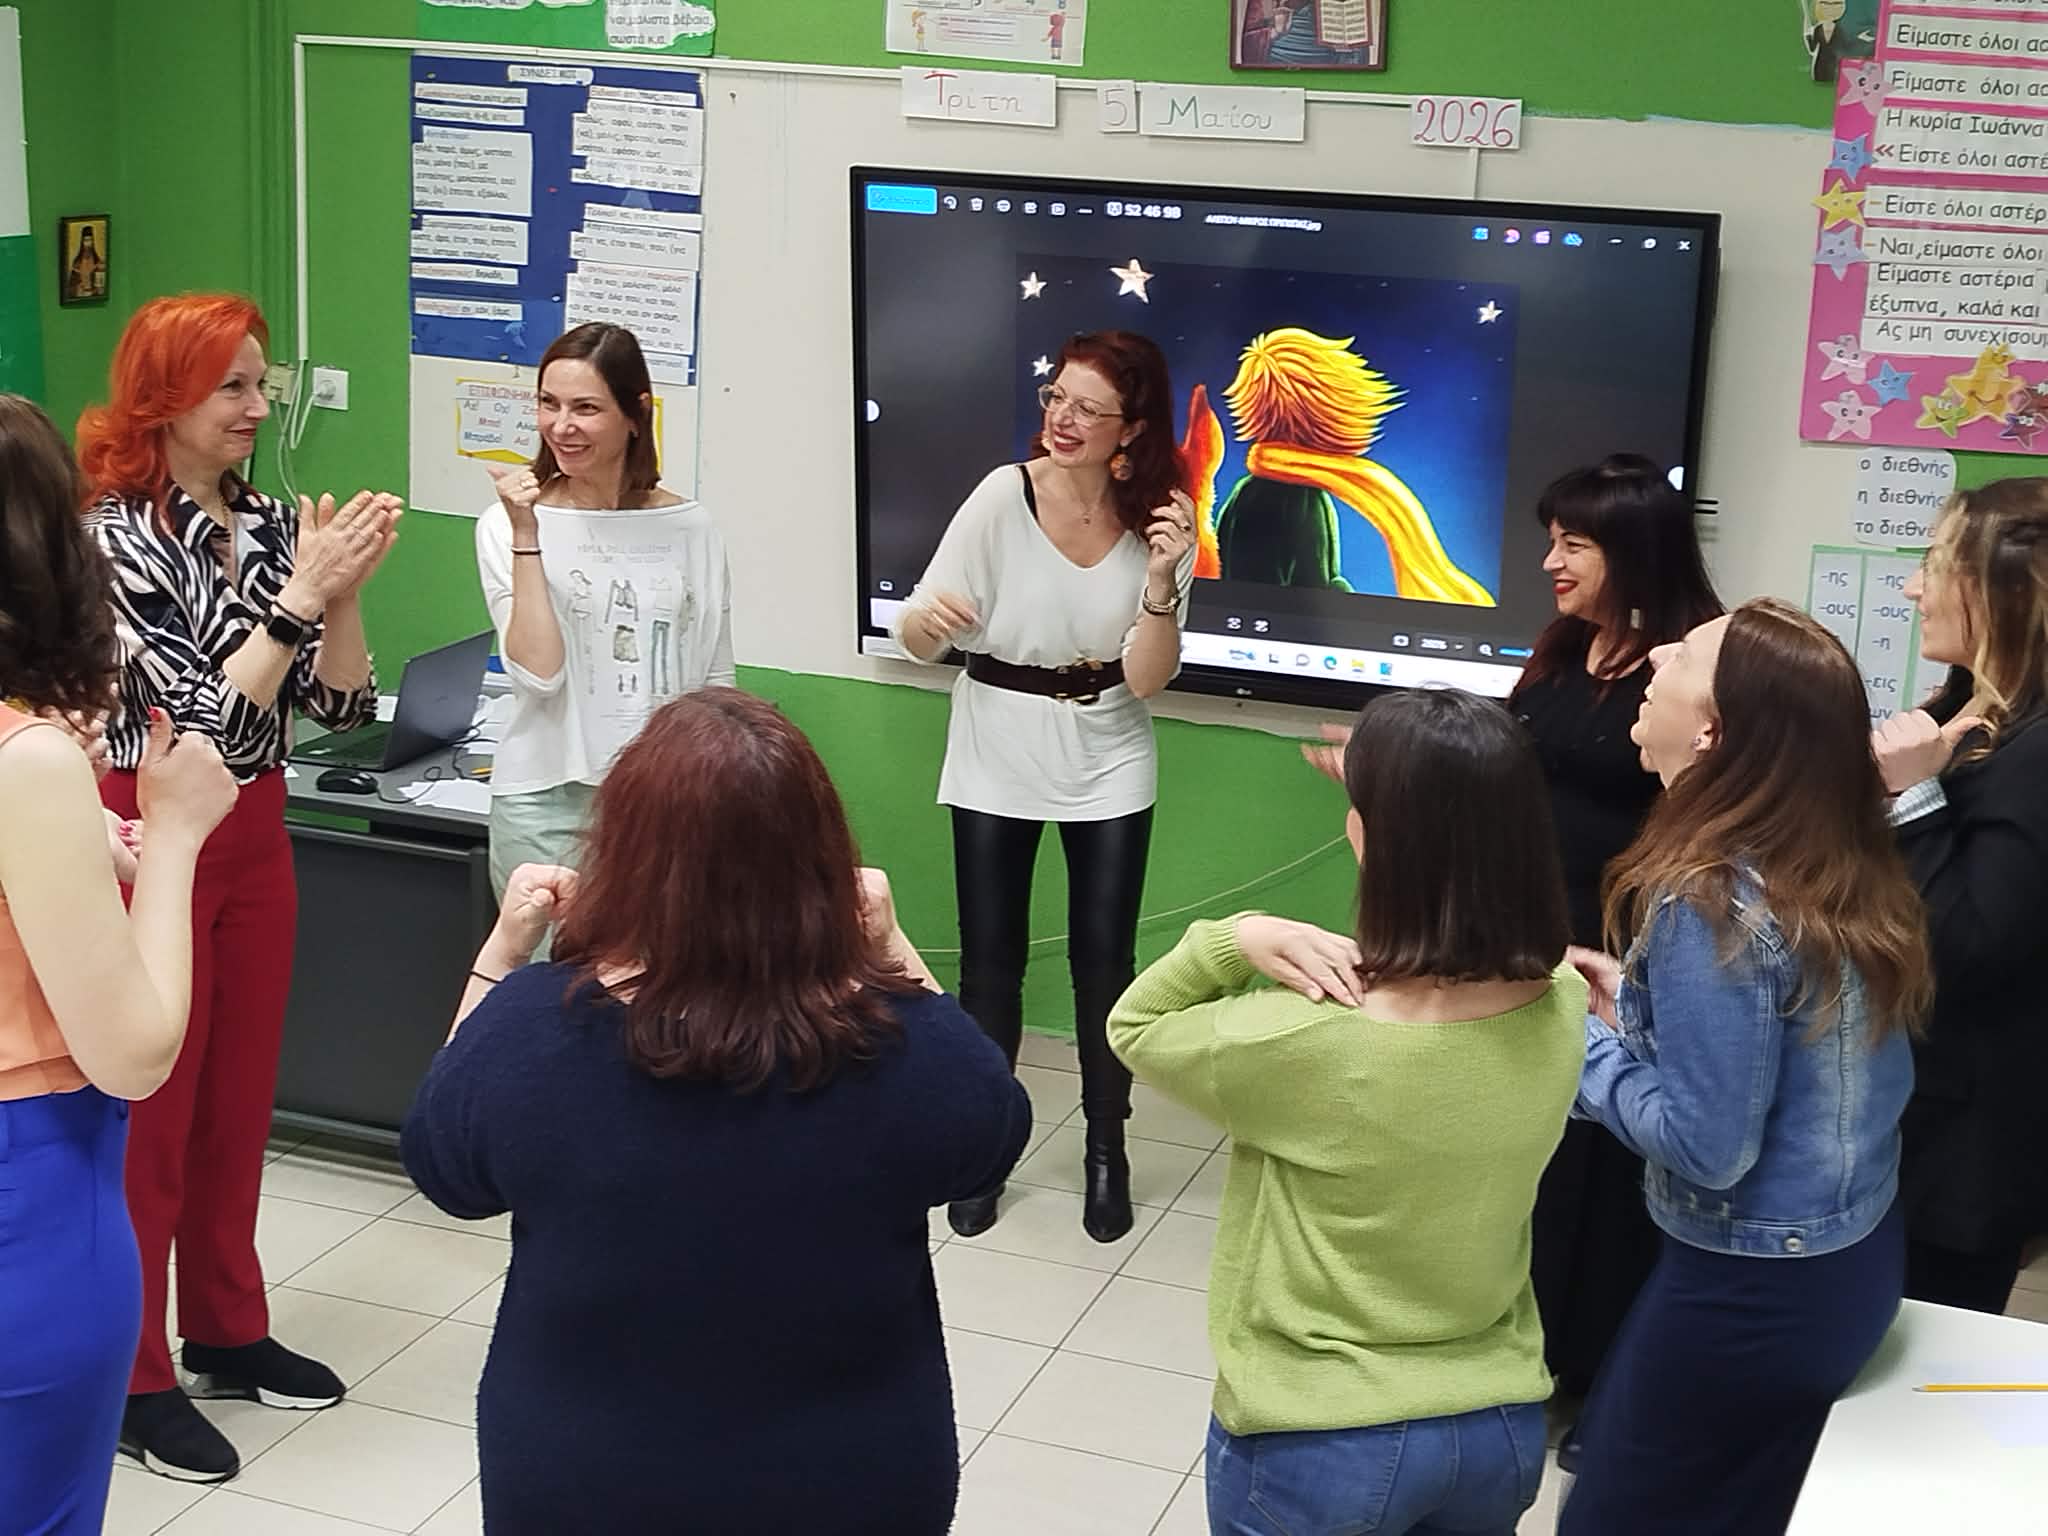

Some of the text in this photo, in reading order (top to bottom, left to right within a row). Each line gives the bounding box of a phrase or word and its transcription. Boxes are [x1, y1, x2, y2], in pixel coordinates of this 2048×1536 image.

[1897, 23, 1973, 49] Είμαστε
[1979, 32, 2019, 50] όλοι
[1891, 71, 1967, 95] Είμαστε
[1980, 76, 2020, 96] όλοι
[1103, 88, 1128, 127] 5
[1414, 98, 1517, 147] 2026
[1886, 108, 2044, 137] Η κυρία Ιωάννα
[1957, 148, 1997, 167] όλοι
[1943, 201, 1983, 218] όλοι
[2003, 242, 2043, 262] όλοι
[1877, 262, 2035, 291] Είμαστε αστέρια
[1869, 294, 2041, 319] έξυπνα, καλά και
[1876, 320, 1903, 342] Ας
[1909, 325, 1932, 343] μη
[1860, 456, 1951, 478] ο διεθνής
[1857, 489, 1868, 505] η
[1856, 521, 1874, 535] το
[1821, 571, 1849, 588] -ης
[1877, 574, 1905, 591] -ης
[1819, 603, 1856, 619] -ους
[1872, 606, 1910, 622] -ους
[1872, 637, 1891, 650] -η
